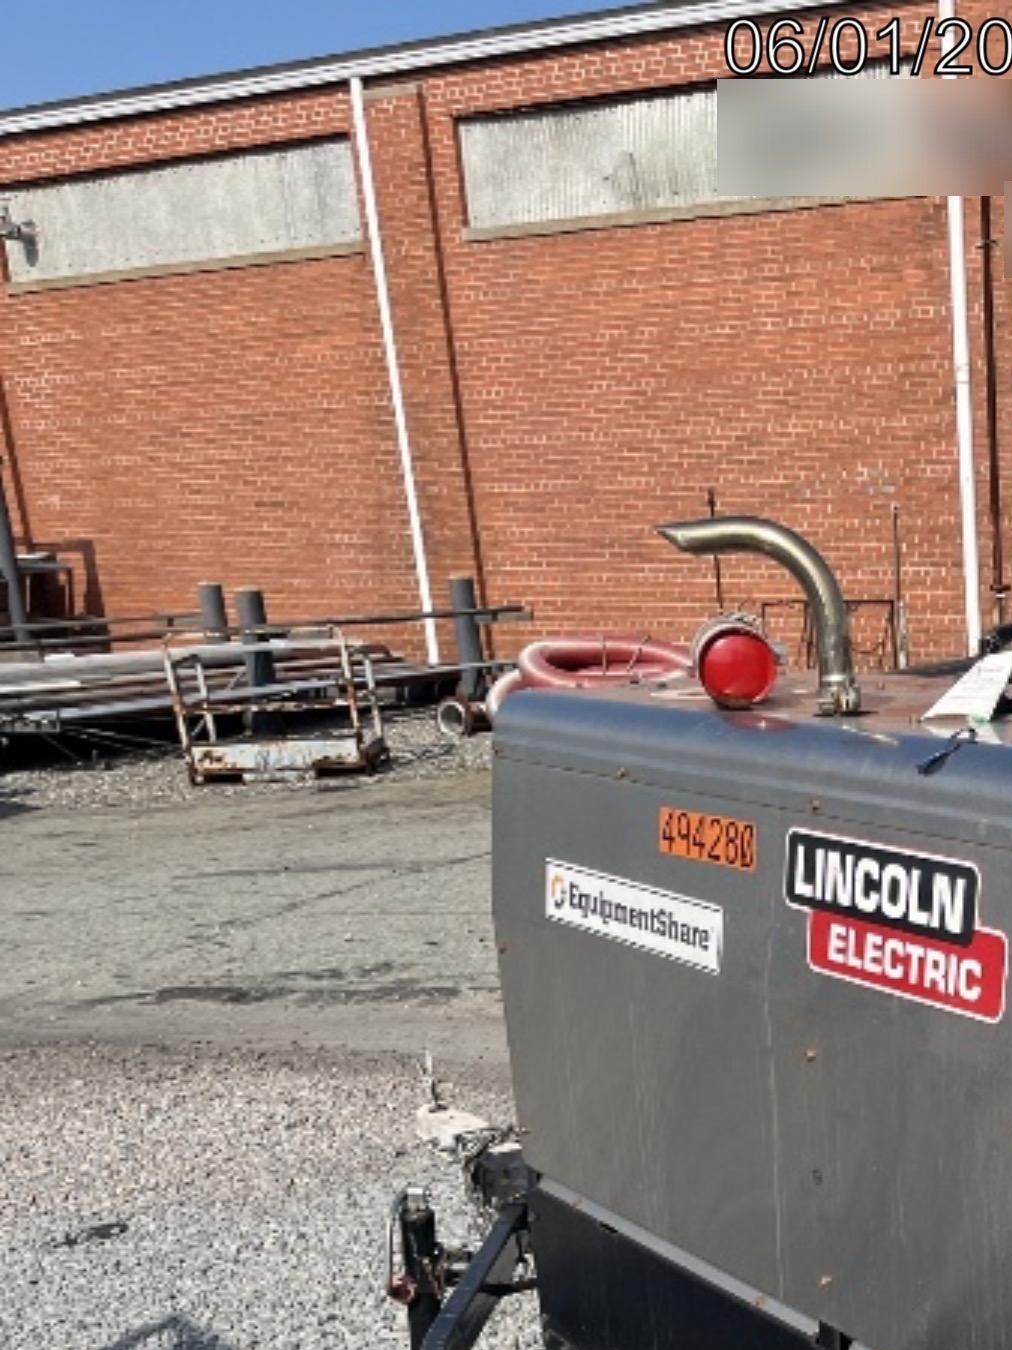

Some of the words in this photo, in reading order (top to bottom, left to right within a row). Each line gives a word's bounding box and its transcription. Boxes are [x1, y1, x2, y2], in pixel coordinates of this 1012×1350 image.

[661, 809, 753, 868] 494280
[569, 881, 710, 951] EquipmentShare
[794, 843, 966, 934] LINCOLN
[827, 923, 982, 1001] ELECTRIC
